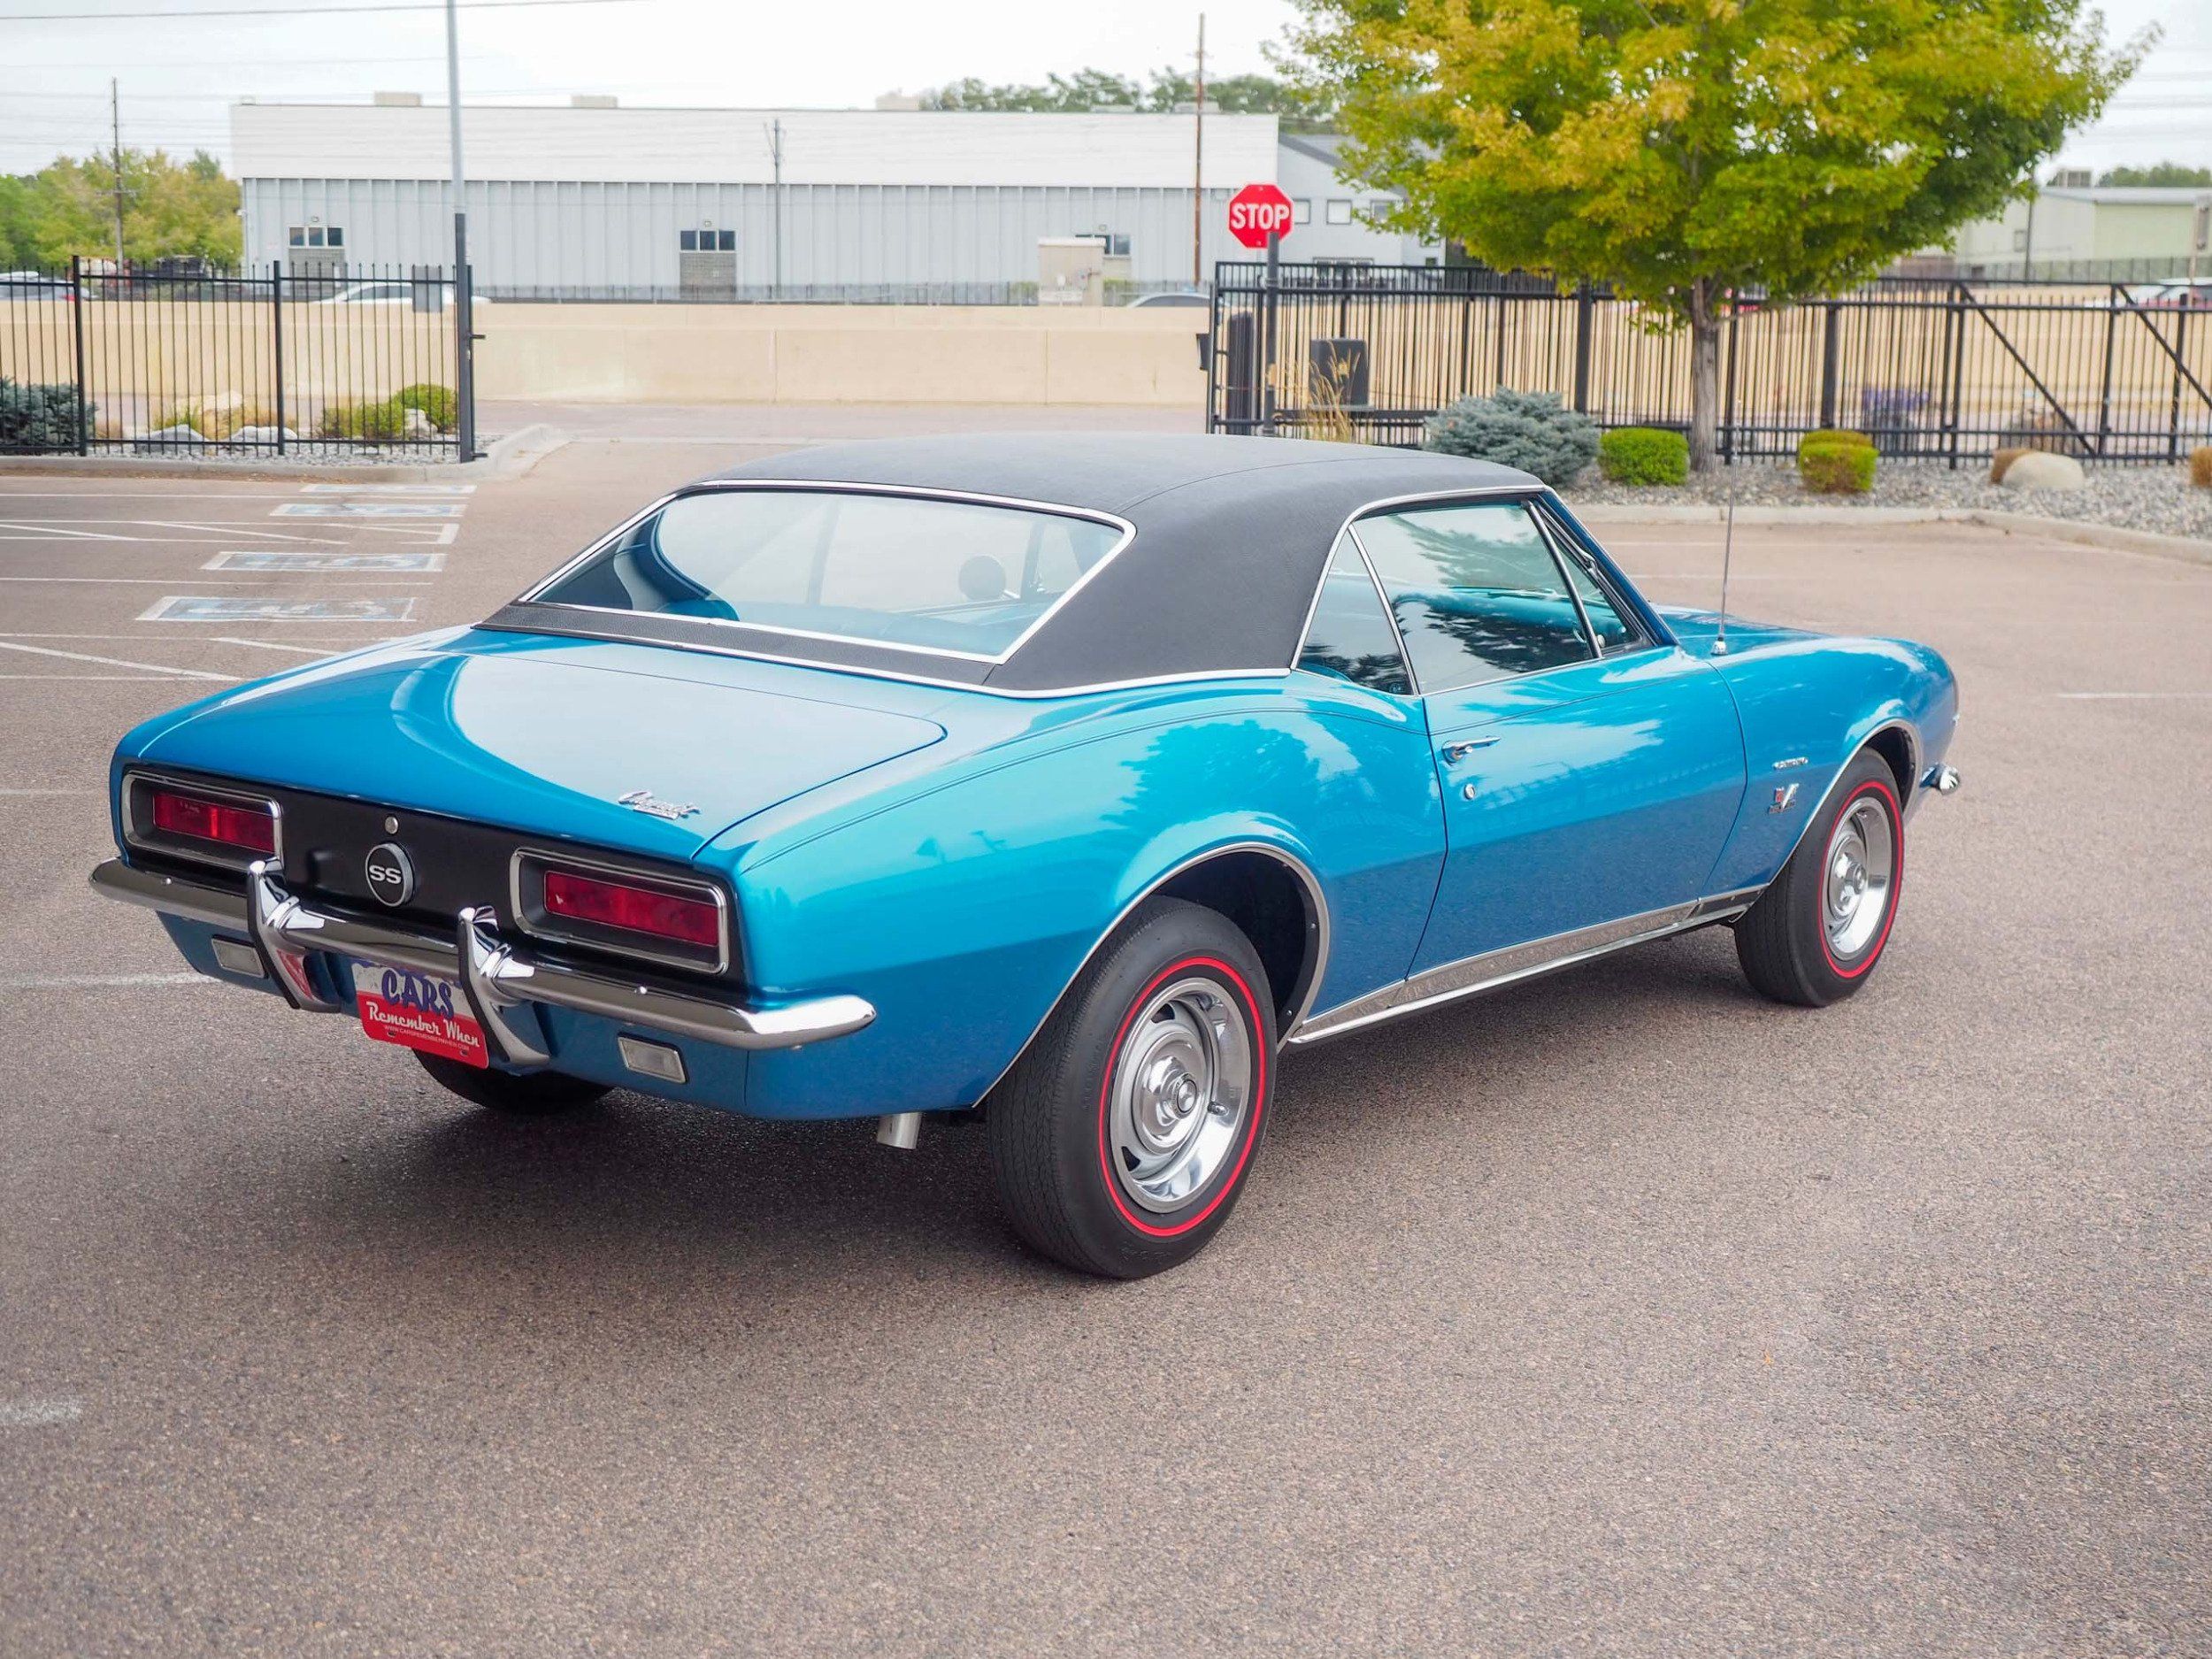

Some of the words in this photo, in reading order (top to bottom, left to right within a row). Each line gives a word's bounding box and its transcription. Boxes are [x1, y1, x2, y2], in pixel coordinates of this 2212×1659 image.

[1231, 203, 1289, 230] STOP
[369, 864, 402, 884] SS
[381, 970, 455, 1019] CARS
[365, 1001, 442, 1036] Remember
[444, 1019, 480, 1048] When
